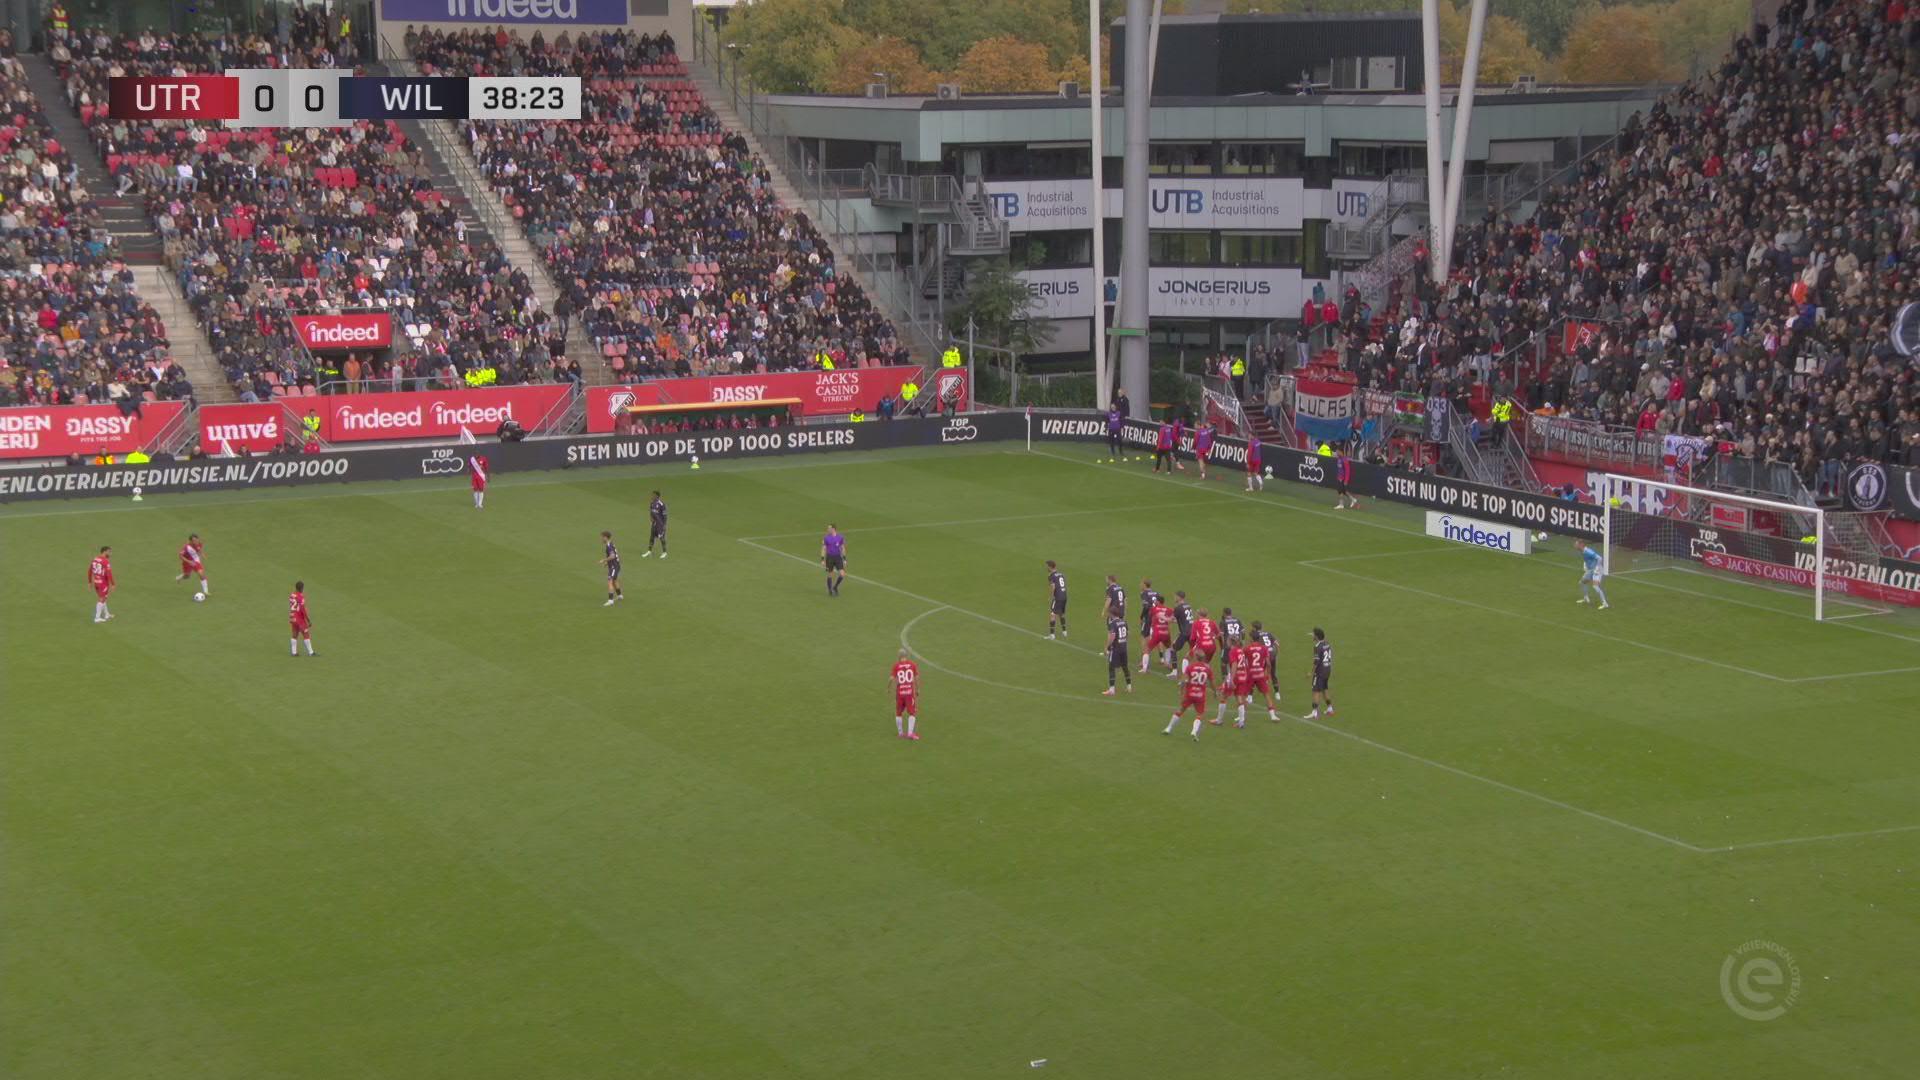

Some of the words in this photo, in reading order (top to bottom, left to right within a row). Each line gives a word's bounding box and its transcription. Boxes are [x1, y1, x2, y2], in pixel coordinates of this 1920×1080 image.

[1027, 191, 1073, 203] Industrial
[1152, 189, 1204, 214] UTB
[1212, 190, 1265, 201] Industrial
[987, 193, 1020, 217] TB
[1027, 206, 1087, 218] Acquisitions
[1212, 205, 1280, 216] Acquisitions
[1337, 191, 1368, 218] UTB
[1028, 281, 1080, 296] ERIUS
[1158, 280, 1271, 295] JONGERIUS
[1174, 297, 1221, 306] INVEST
[308, 323, 379, 343] indeed
[816, 372, 859, 385] JACK'S
[713, 385, 766, 402] DASSY
[816, 385, 860, 396] CASINO
[823, 395, 852, 403] UTRECHT
[1298, 395, 1347, 418] LUCAS
[1426, 396, 1447, 413] 033
[342, 405, 422, 430] indeed
[435, 402, 511, 425] indeed
[949, 418, 969, 427] TOP
[65, 416, 132, 436] DASSY
[207, 415, 278, 441] univé
[942, 425, 977, 442] 1000
[567, 443, 610, 462] STEM
[616, 442, 639, 458] NU
[646, 440, 669, 456] OP
[675, 439, 696, 455] DE
[702, 437, 733, 453] TOP
[739, 434, 782, 451] 1000
[787, 429, 855, 447] SPELERS
[432, 449, 454, 458] TOP
[1304, 455, 1319, 466] TOP
[422, 456, 464, 475] 1000
[1387, 476, 1416, 496] STEM
[1420, 482, 1437, 501] NU
[1441, 486, 1458, 505] OP
[1462, 490, 1478, 509] DE
[1482, 494, 1507, 516] TOP
[1511, 499, 1545, 522] 1000
[1550, 506, 1606, 534] SPELERS
[1443, 519, 1511, 550] indeed
[1699, 529, 1718, 542] TOP
[1726, 556, 1761, 575] JACK'S
[1763, 566, 1807, 585] CASINO
[1810, 574, 1848, 592] Urecht
[1202, 622, 1211, 634] 3
[1227, 623, 1240, 635] 52
[1263, 635, 1271, 647] 5
[1252, 652, 1261, 666] 2
[897, 669, 914, 684] 80
[1191, 671, 1208, 685] 20
